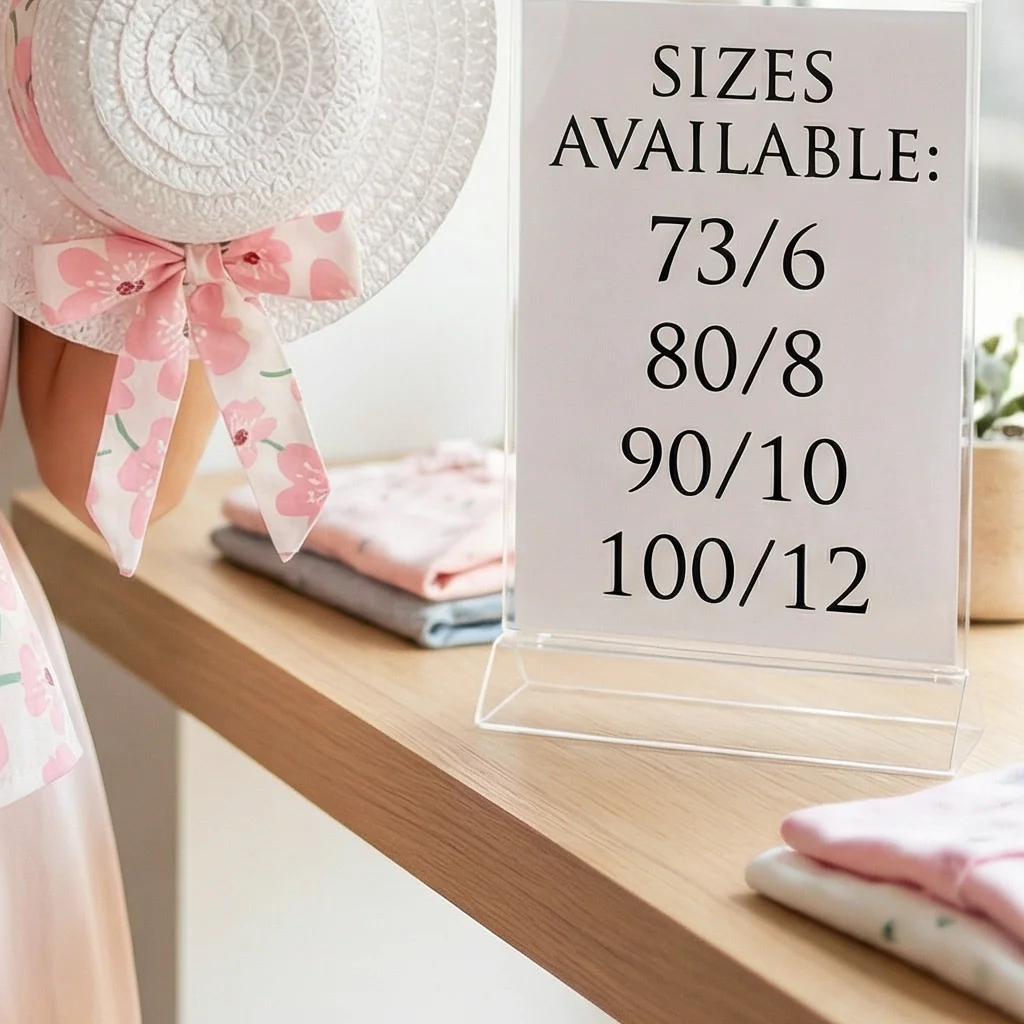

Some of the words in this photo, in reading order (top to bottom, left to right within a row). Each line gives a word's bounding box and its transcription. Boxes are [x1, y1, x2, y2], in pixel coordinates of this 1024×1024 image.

[652, 44, 834, 104] SIZES
[548, 114, 938, 183] AVAILABLE:
[650, 215, 825, 291] 73/6
[646, 322, 824, 398] 80/8
[621, 426, 847, 506] 90/10
[602, 531, 870, 615] 100/12
